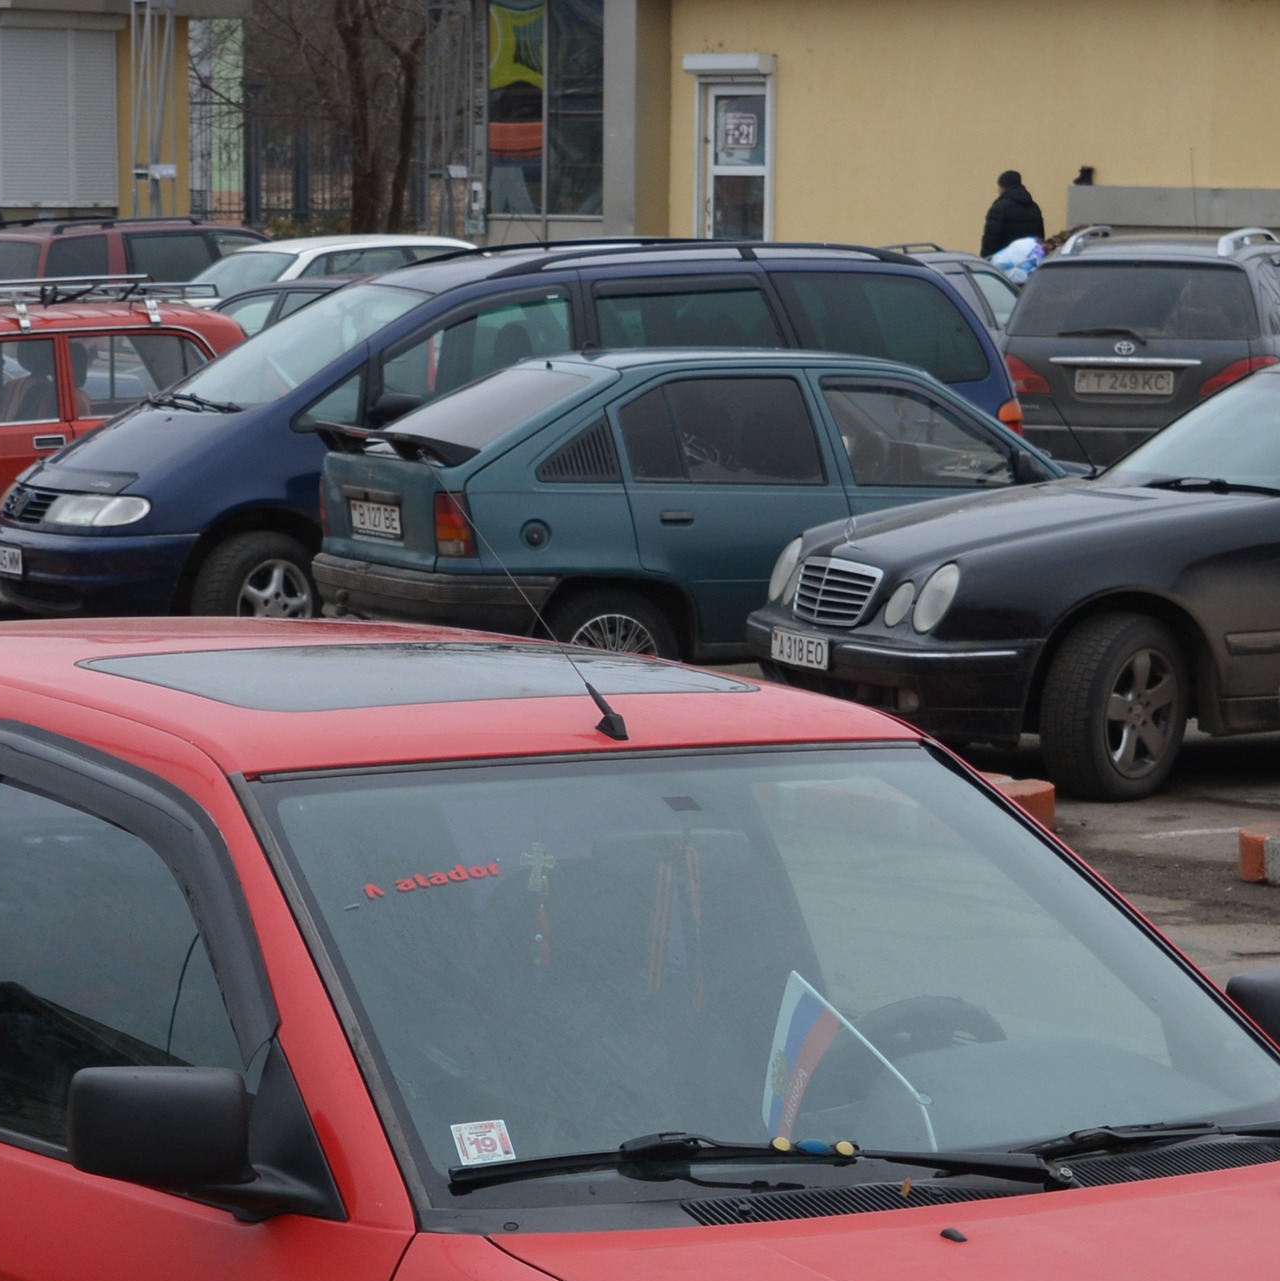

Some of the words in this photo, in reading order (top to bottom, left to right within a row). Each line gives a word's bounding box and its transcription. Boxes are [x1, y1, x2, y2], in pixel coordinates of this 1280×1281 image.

[1109, 374, 1138, 390] 249
[1142, 375, 1166, 391] KC
[786, 635, 804, 662] 318
